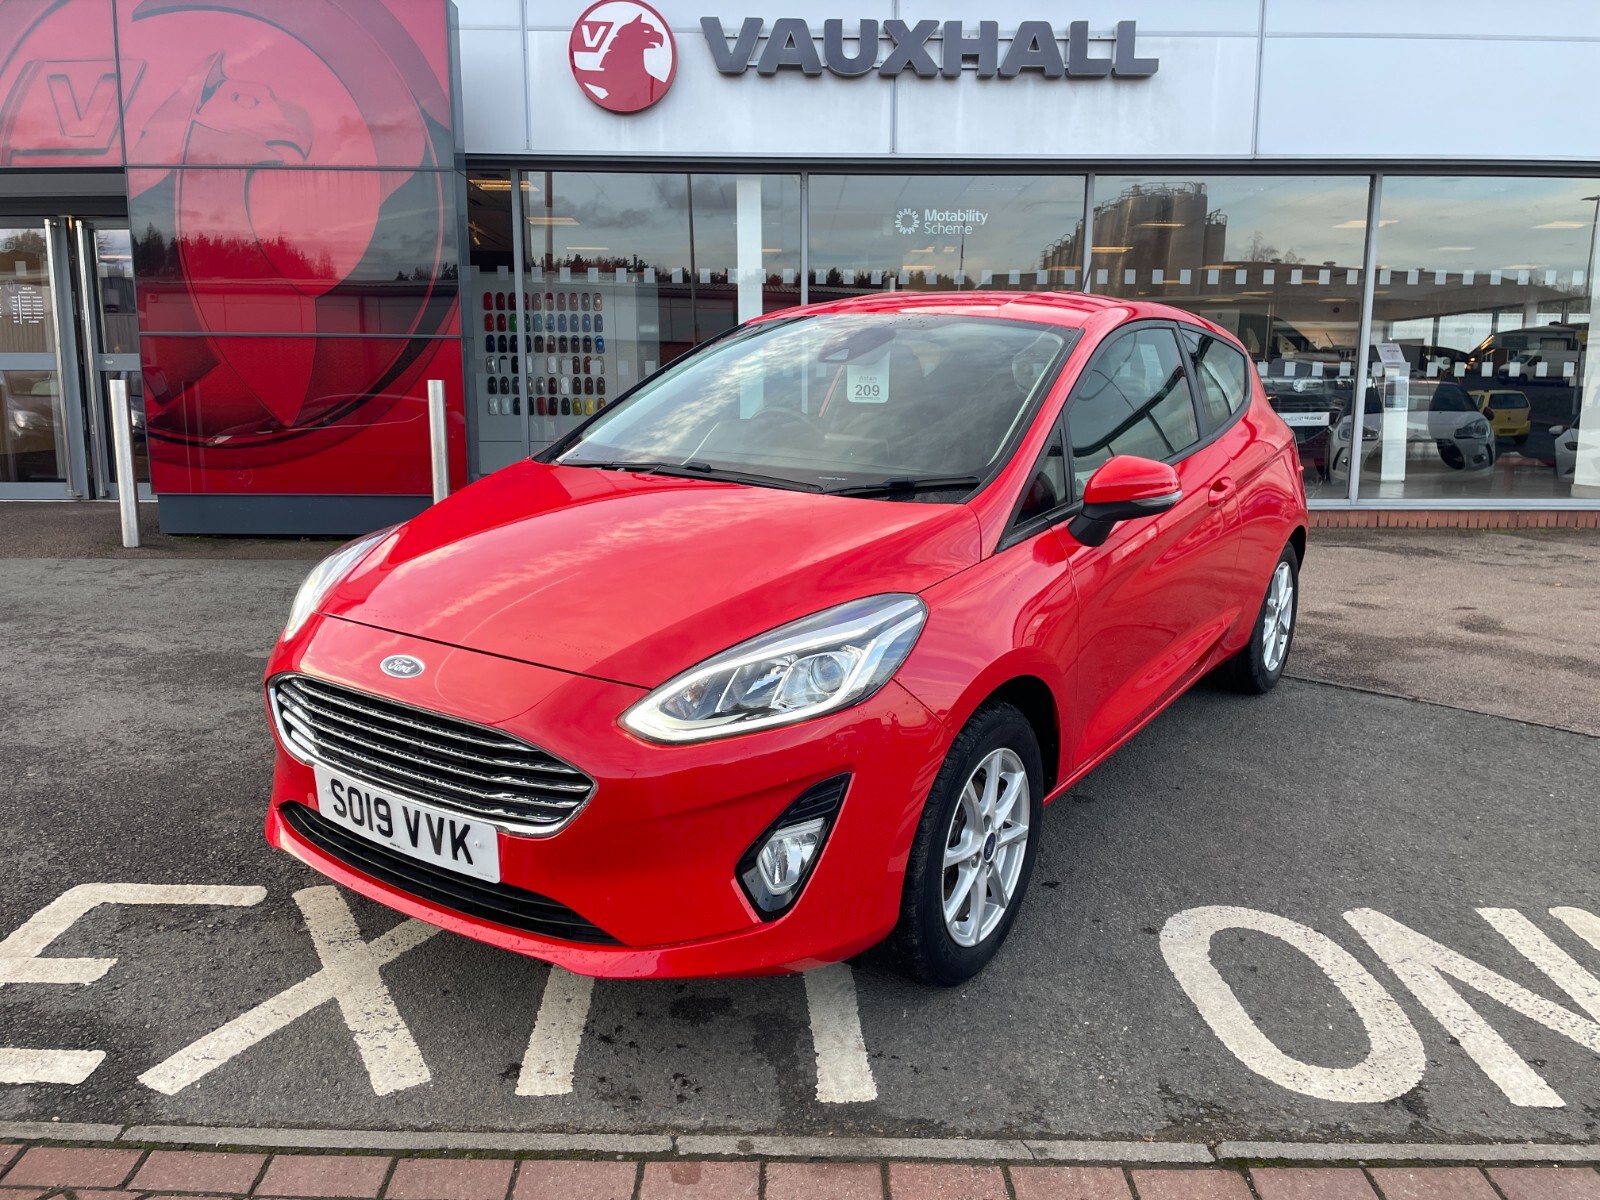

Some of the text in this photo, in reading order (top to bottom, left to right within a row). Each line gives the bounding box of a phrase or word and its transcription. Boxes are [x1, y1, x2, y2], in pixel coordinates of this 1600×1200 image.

[699, 16, 1159, 78] VAUXHALL
[924, 208, 989, 226] Motability
[924, 222, 973, 235] Scheme
[855, 384, 880, 397] 209
[387, 659, 416, 674] Ford
[330, 778, 474, 866] SO19 VVK
